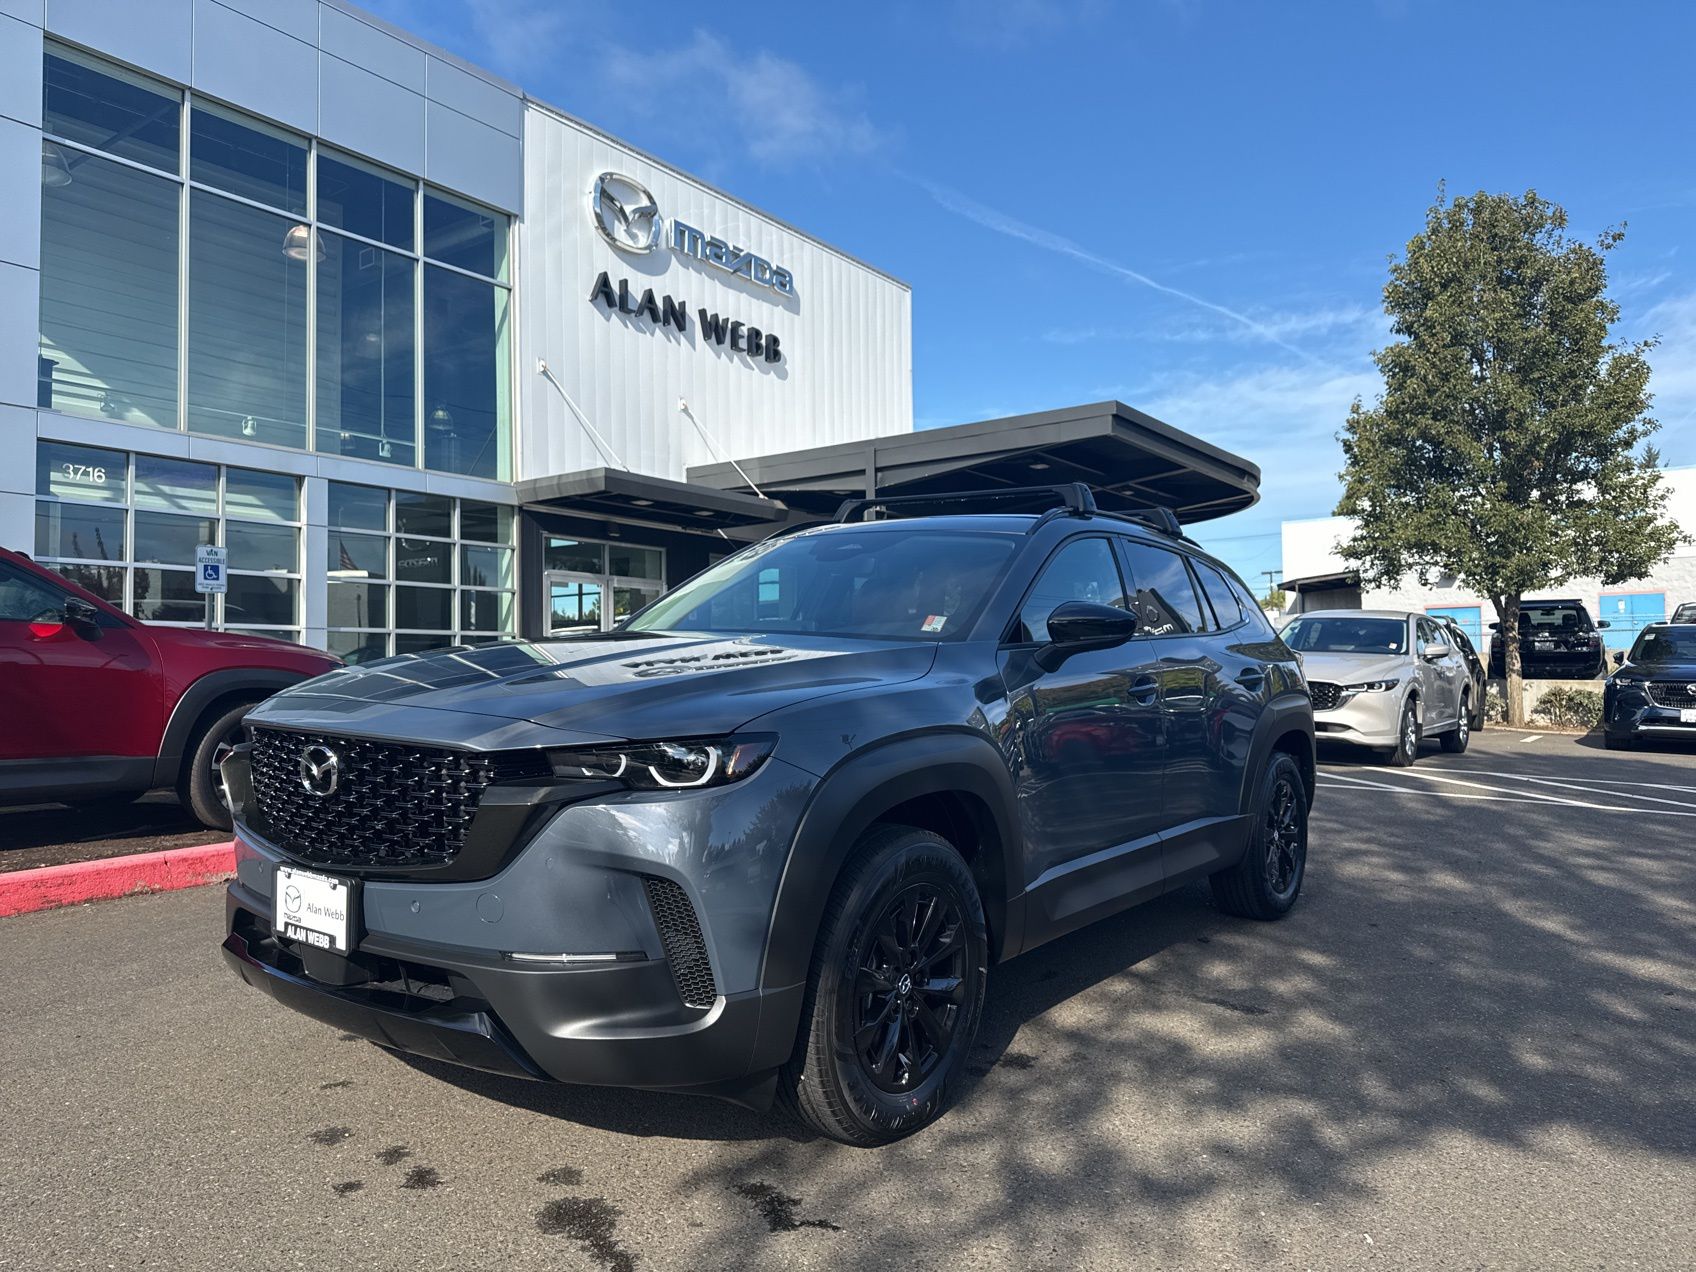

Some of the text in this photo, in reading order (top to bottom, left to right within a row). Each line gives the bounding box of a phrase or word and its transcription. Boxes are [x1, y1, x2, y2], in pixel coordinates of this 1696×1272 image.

[667, 217, 795, 298] mazda
[588, 271, 782, 364] ALAN WEBB
[62, 463, 106, 483] 3716
[206, 549, 218, 557] VAN
[306, 902, 345, 921] Alan Webb
[287, 924, 330, 949] ALAN WEBB
